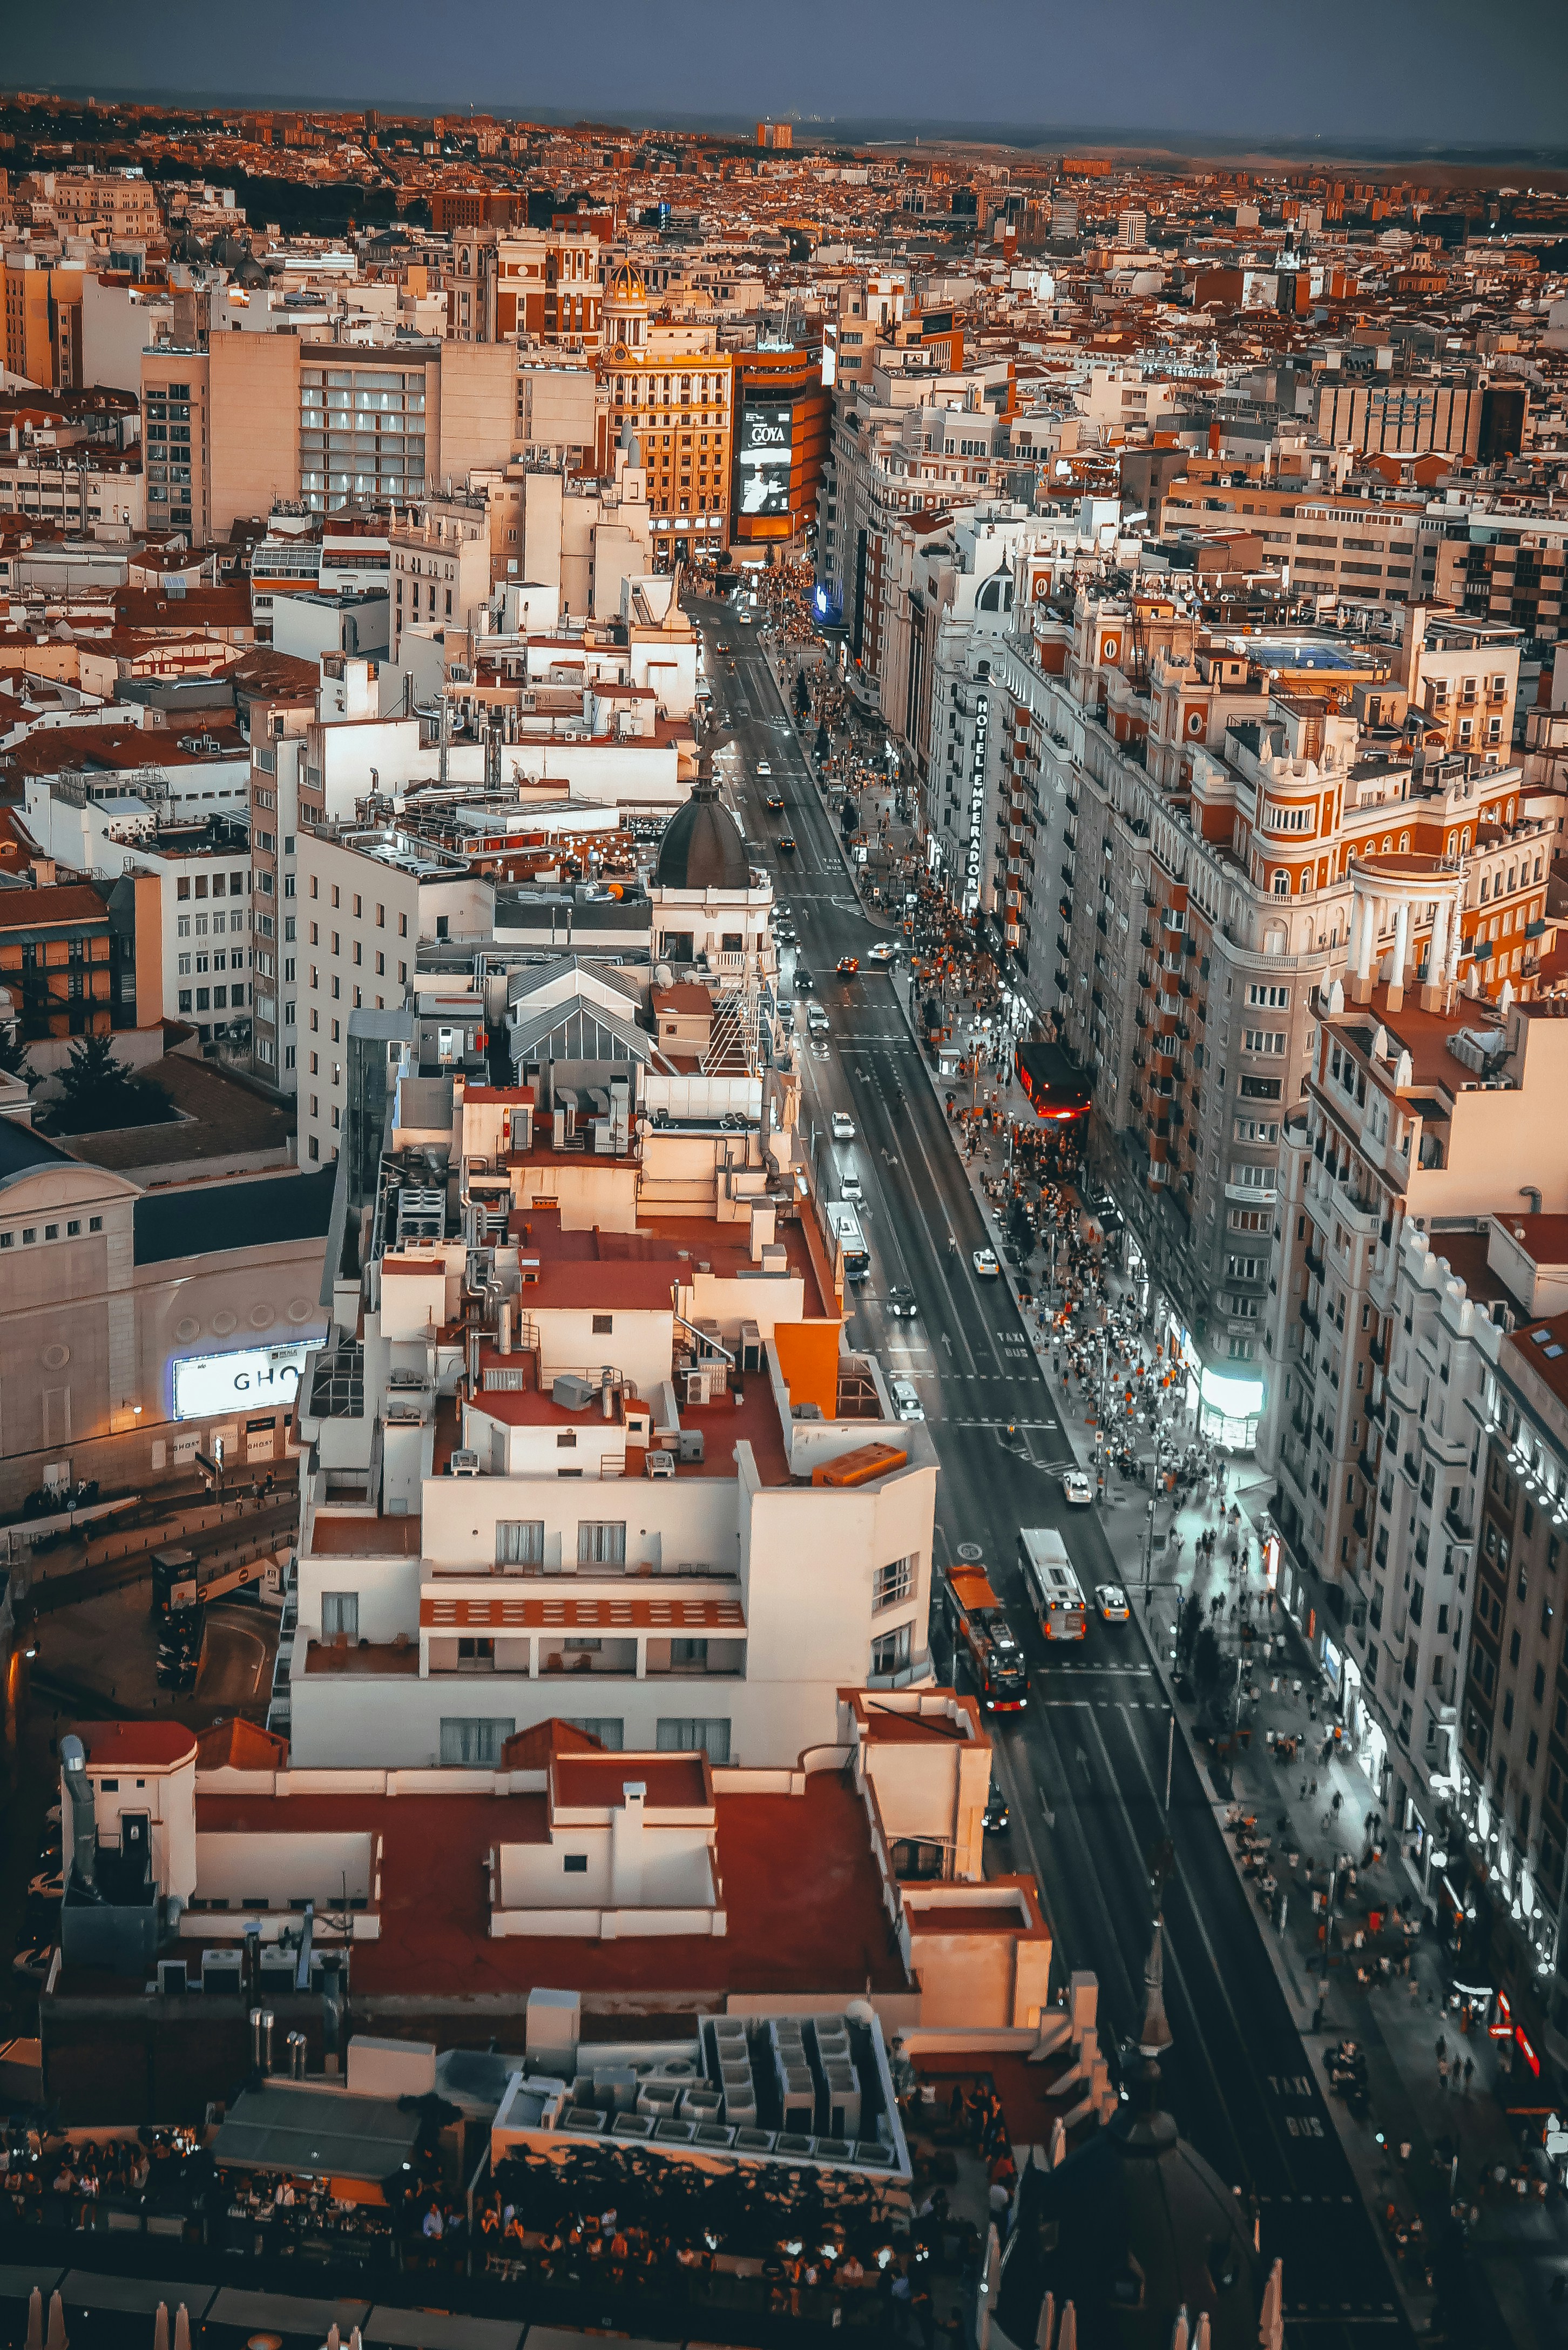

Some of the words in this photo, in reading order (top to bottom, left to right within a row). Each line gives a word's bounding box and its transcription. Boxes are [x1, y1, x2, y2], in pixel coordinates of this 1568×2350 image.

[752, 427, 785, 442] GOYA
[975, 701, 988, 767] HOTEL
[967, 774, 984, 889] EMPERADOR
[997, 1332, 1025, 1342] TAXI
[1004, 1348, 1029, 1358] BUS
[1267, 2076, 1312, 2096] TAXI
[1285, 2115, 1325, 2137] BUS
